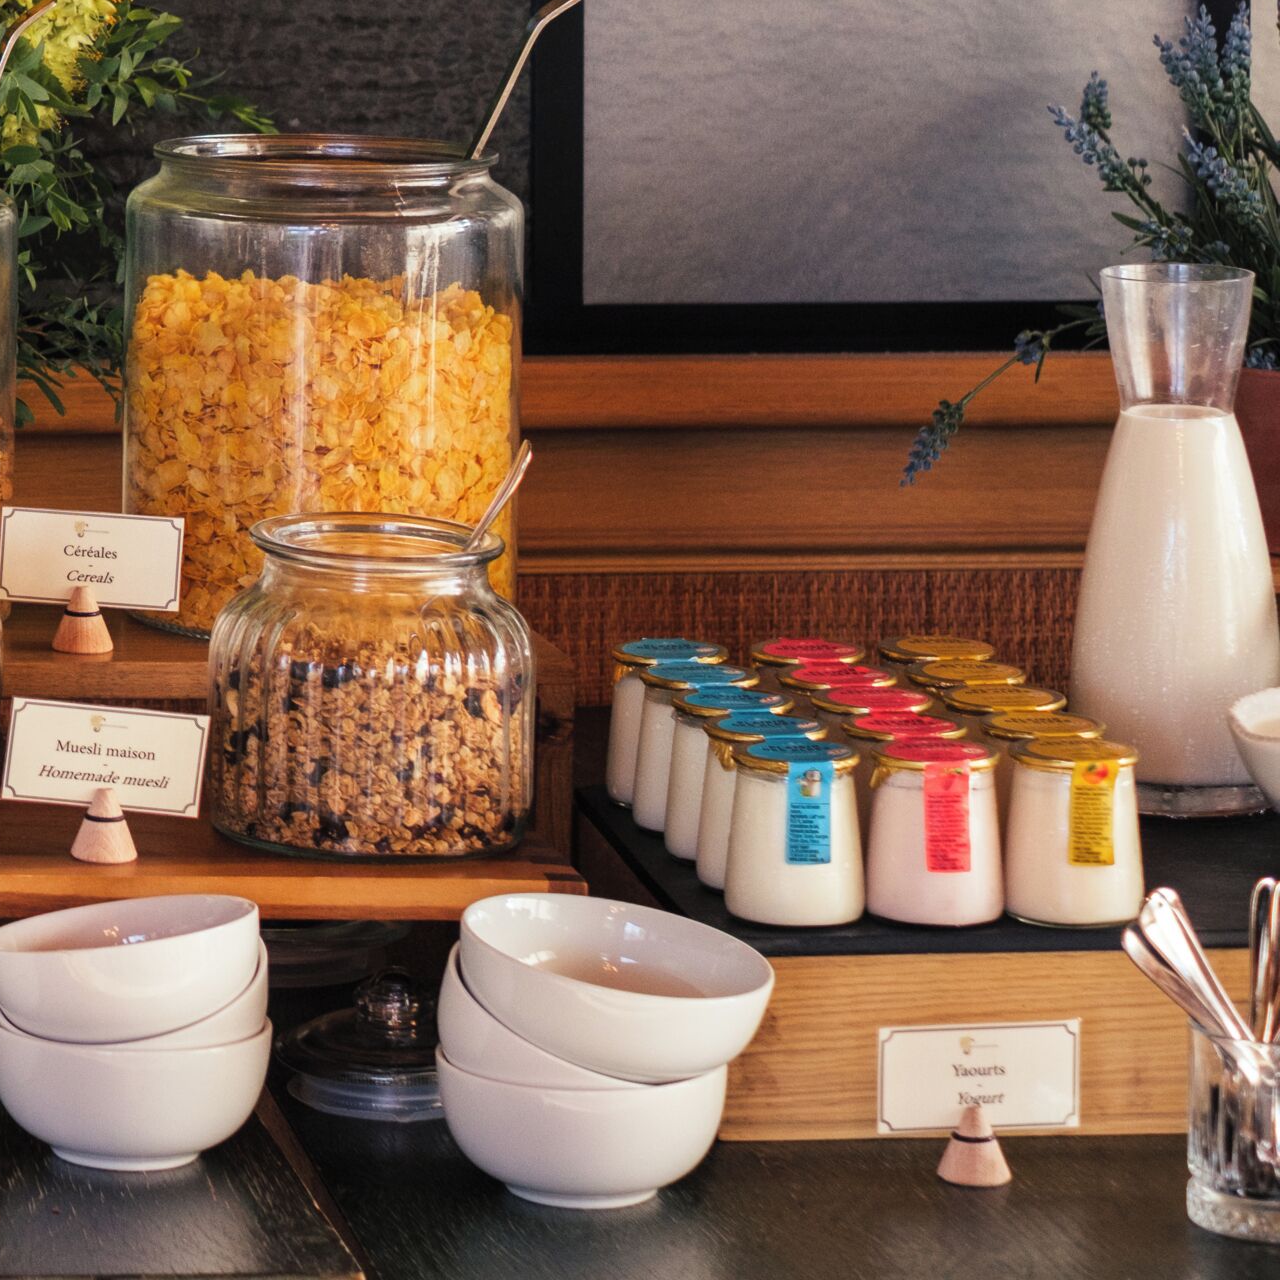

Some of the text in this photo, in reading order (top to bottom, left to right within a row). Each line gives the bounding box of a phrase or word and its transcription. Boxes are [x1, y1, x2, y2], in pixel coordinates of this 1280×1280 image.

[63, 545, 118, 560] Céréales
[66, 570, 115, 584] Cereals
[56, 739, 156, 761] Muesli maison
[38, 765, 171, 789] Homemade muesli
[952, 1064, 1006, 1077] Yaourts
[958, 1091, 1005, 1107] Yogurt
